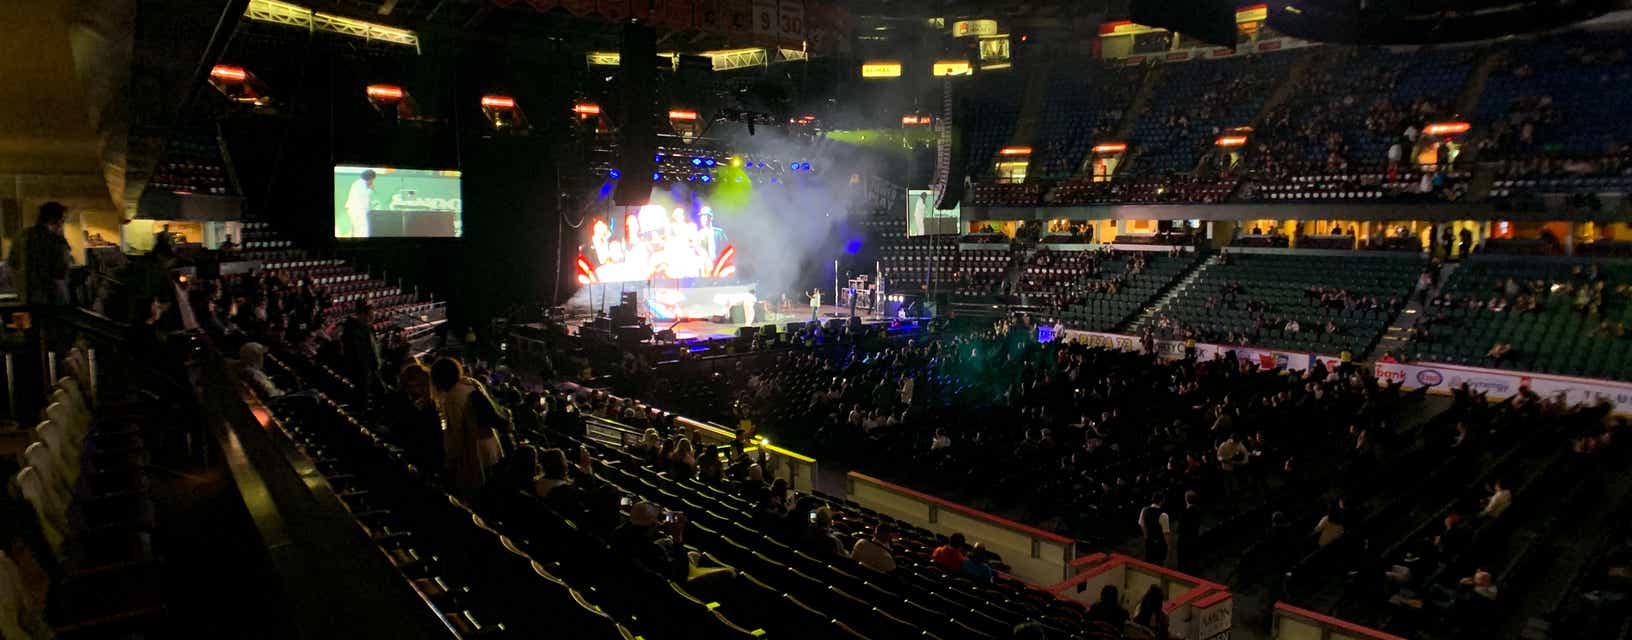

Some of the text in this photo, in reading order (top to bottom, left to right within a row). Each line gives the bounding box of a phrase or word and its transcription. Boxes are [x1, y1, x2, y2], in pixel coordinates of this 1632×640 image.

[1079, 333, 1133, 353] PIZZA 73
[1375, 367, 1405, 380] bank
